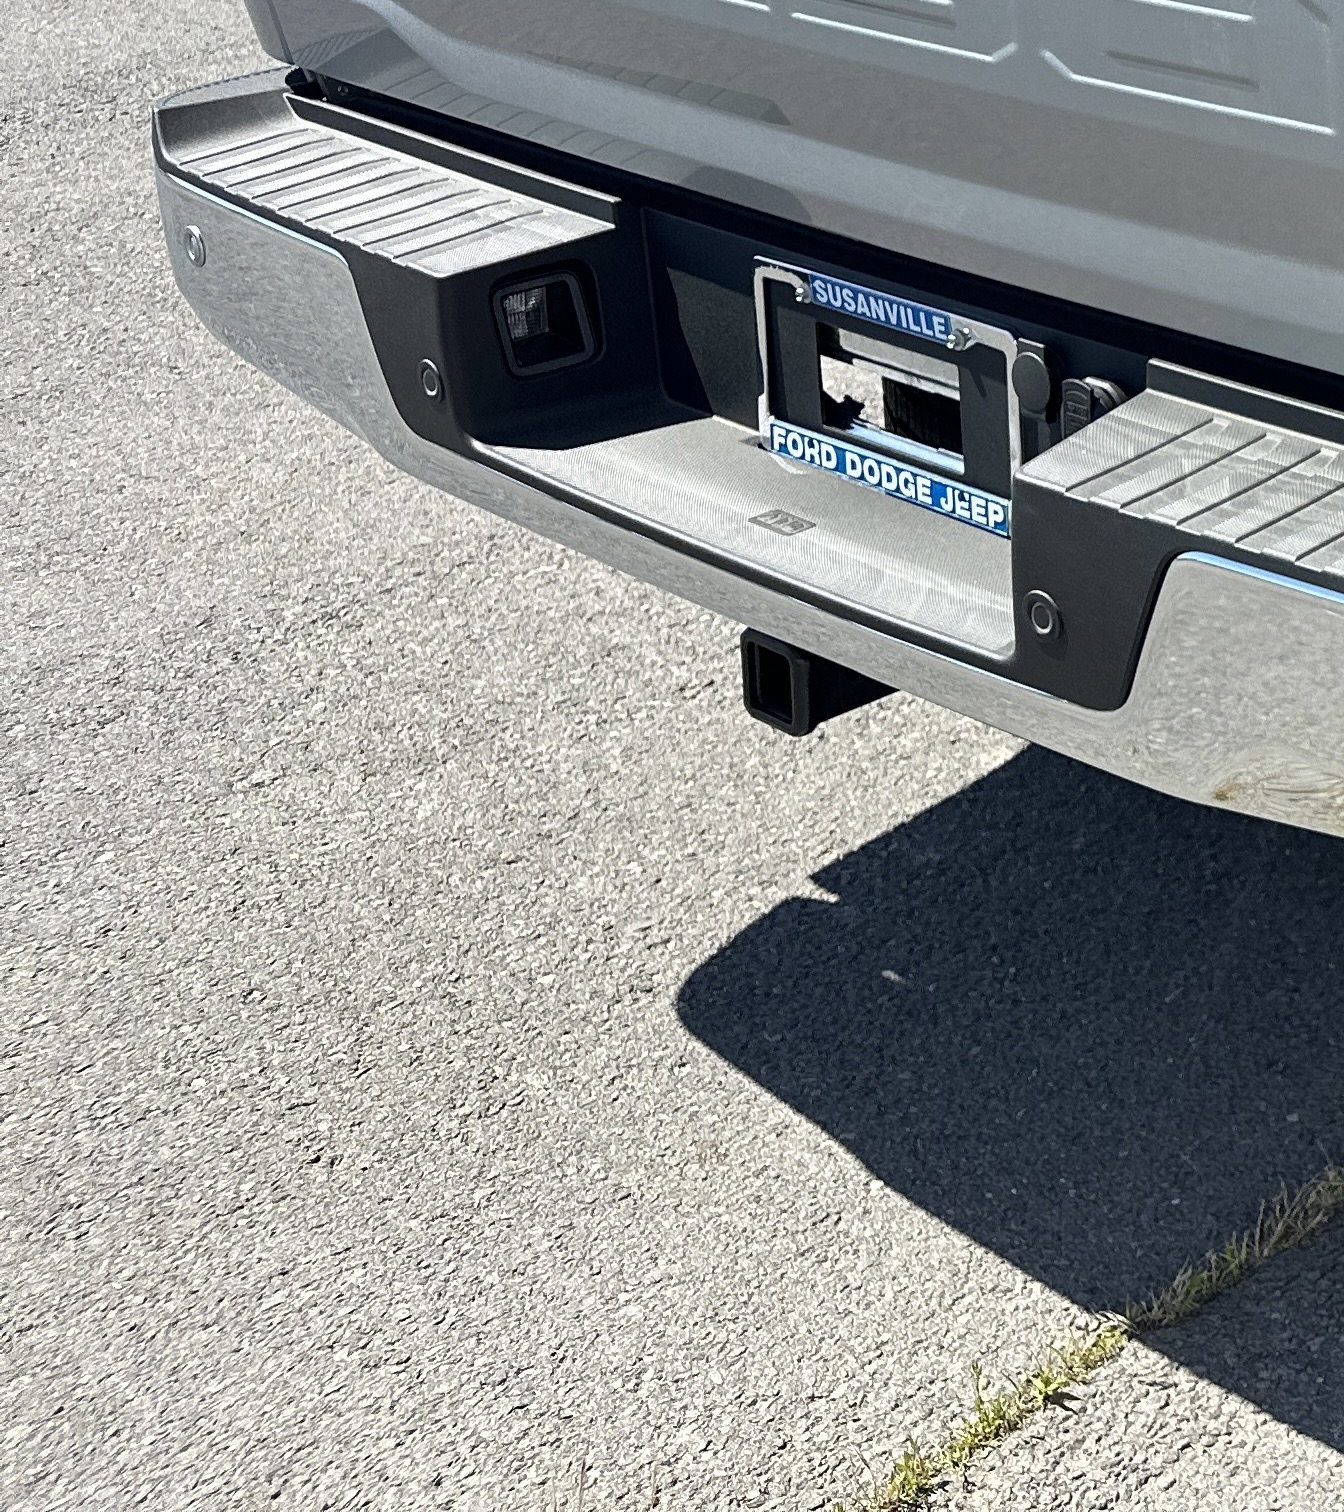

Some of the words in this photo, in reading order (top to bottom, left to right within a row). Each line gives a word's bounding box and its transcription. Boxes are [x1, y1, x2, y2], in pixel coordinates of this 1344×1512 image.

[813, 278, 948, 339] SUSANVILLE
[772, 425, 837, 470] FORD
[846, 451, 933, 505] DODGE
[940, 487, 1004, 528] JEEP
